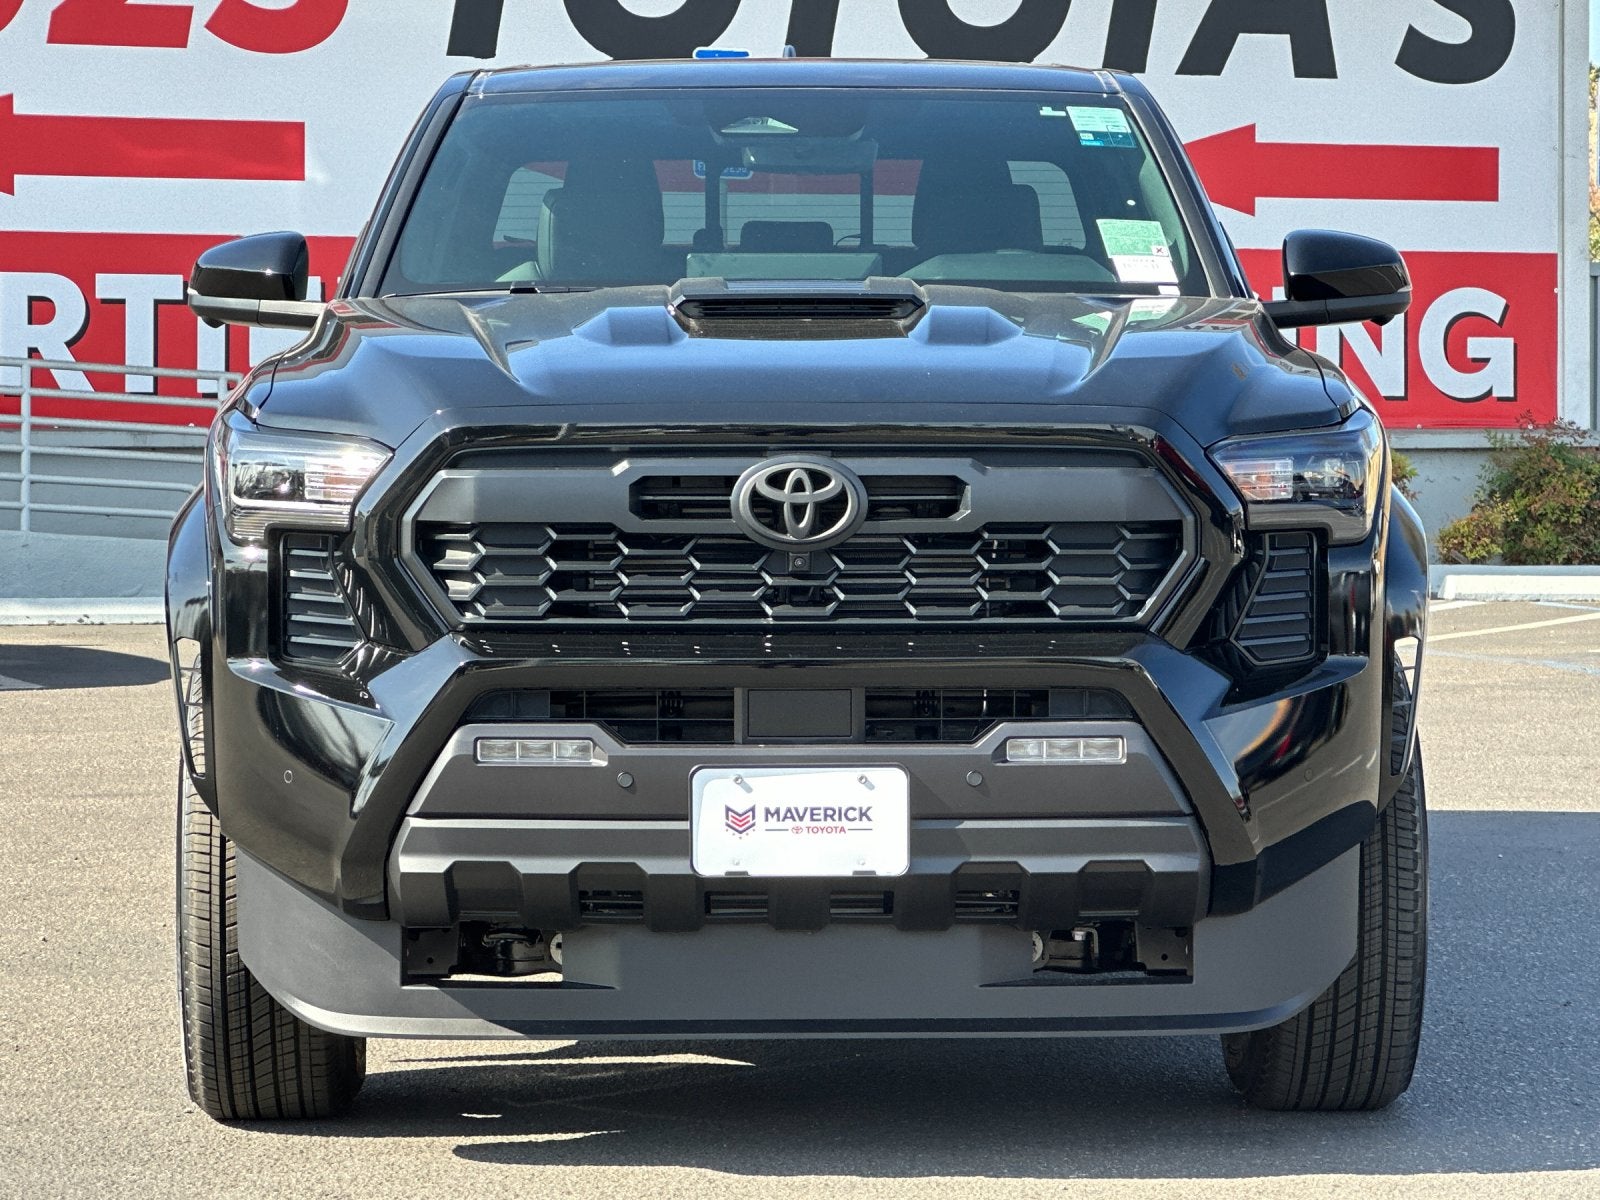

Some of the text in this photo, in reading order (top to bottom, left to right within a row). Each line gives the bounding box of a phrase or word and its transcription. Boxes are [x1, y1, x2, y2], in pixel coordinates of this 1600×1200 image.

[1272, 287, 1514, 399] NG
[764, 807, 872, 822] MAVERICK
[806, 826, 846, 834] TOYOTA
